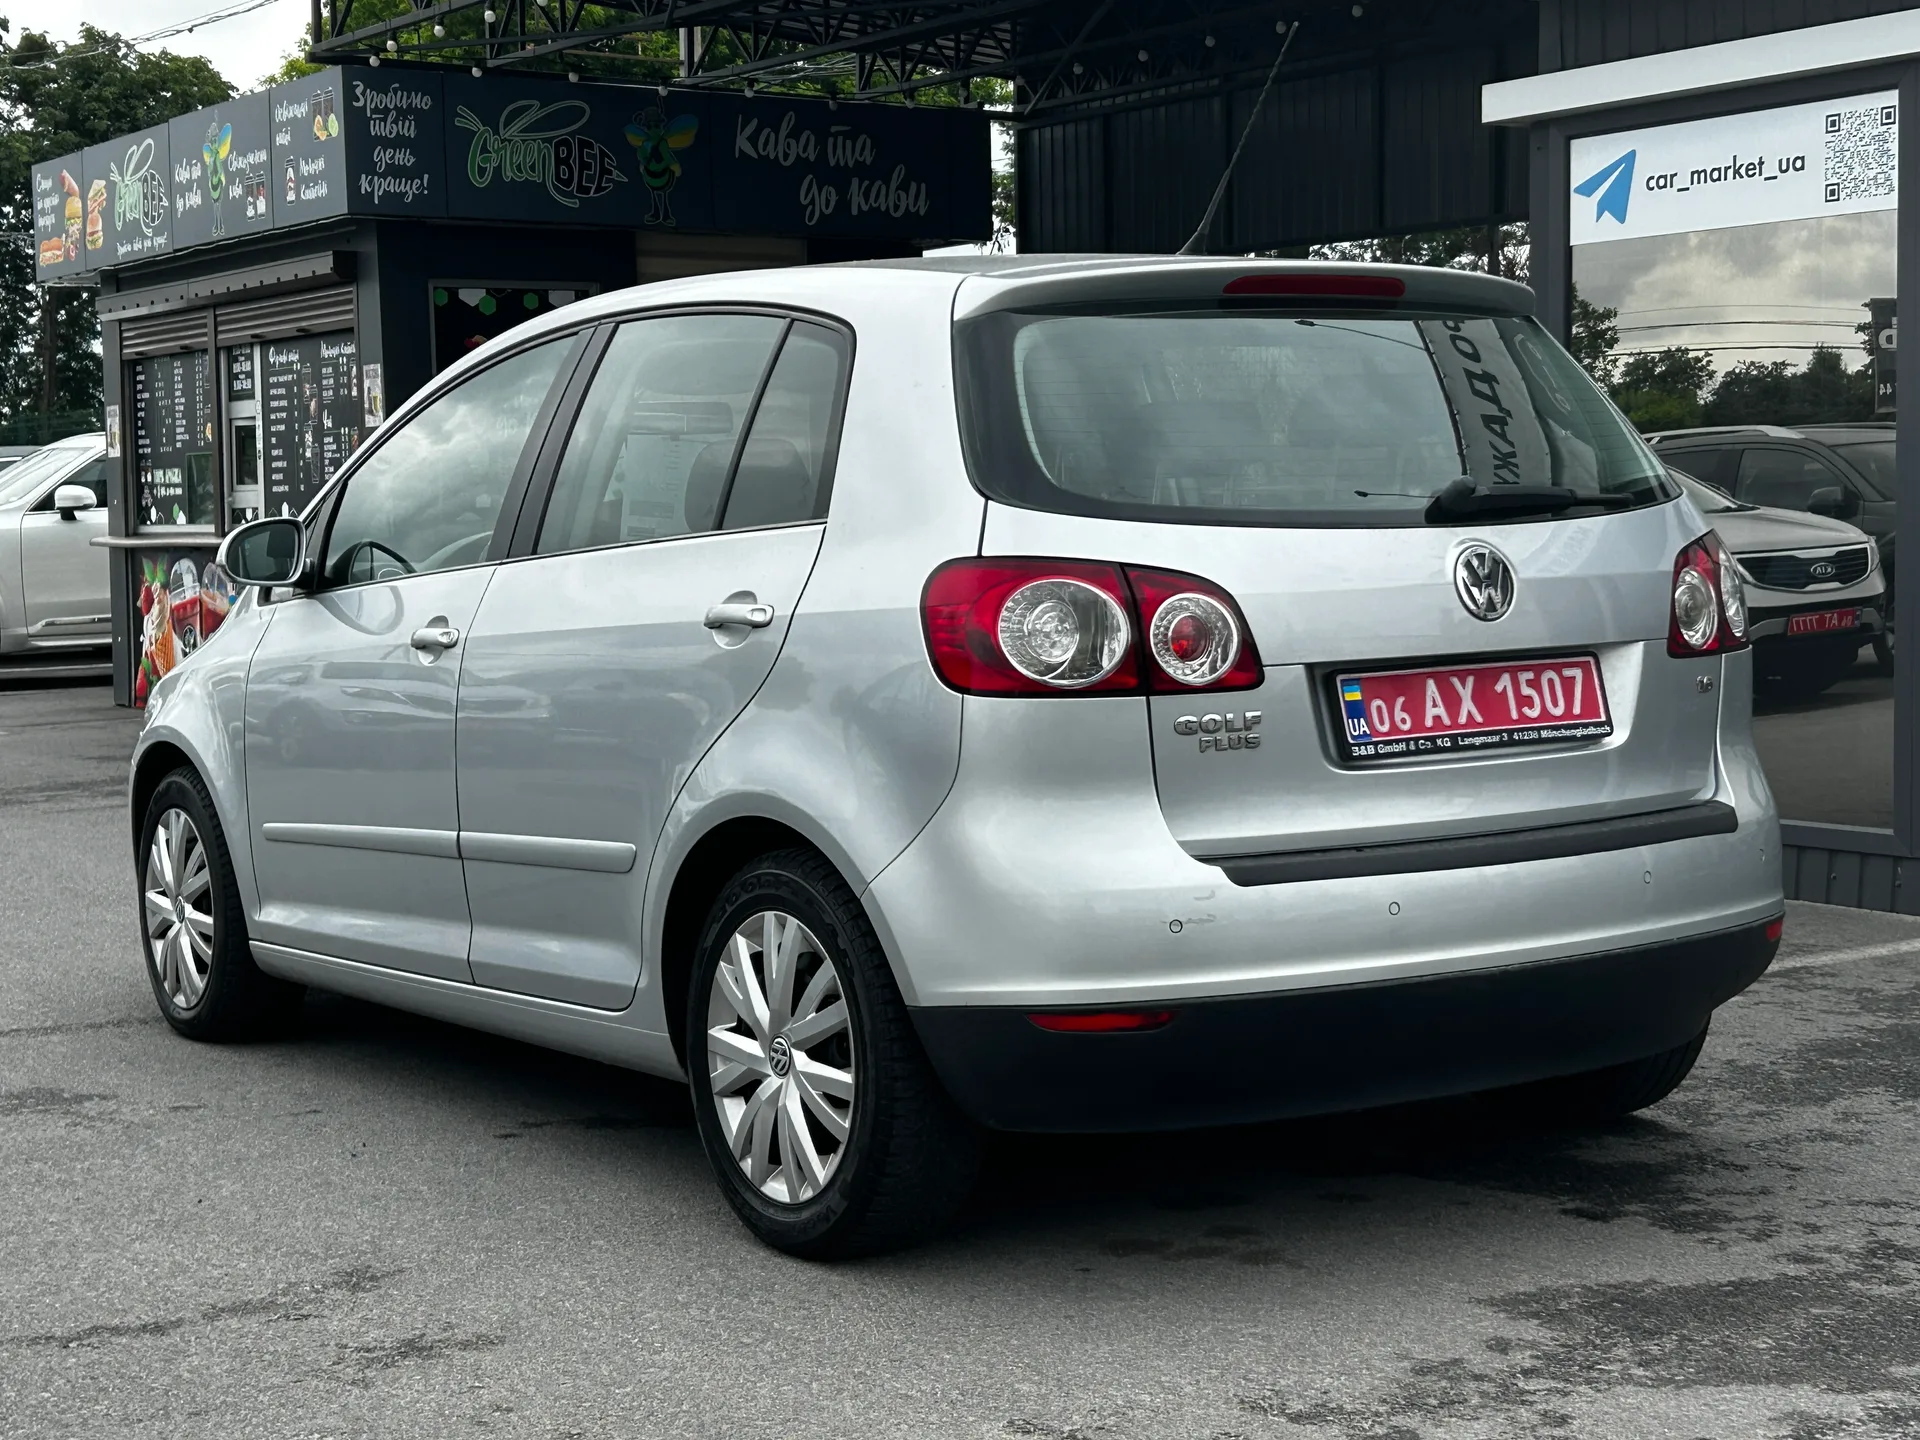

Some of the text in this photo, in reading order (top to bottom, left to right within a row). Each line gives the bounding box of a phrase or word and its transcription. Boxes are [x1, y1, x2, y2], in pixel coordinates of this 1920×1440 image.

[352, 80, 432, 117] Зробимо
[370, 110, 417, 138] твій
[735, 111, 876, 168] Кава та
[373, 145, 416, 172] день
[1646, 155, 1806, 192] car_market_ua
[358, 173, 430, 205] краще!
[800, 164, 930, 226] до кави
[1370, 667, 1584, 733] 06 AX 1507
[1174, 710, 1262, 736] GOLF
[1349, 718, 1370, 736] UA
[1199, 733, 1261, 753] PLUS
[1378, 742, 1406, 754] GmbH
